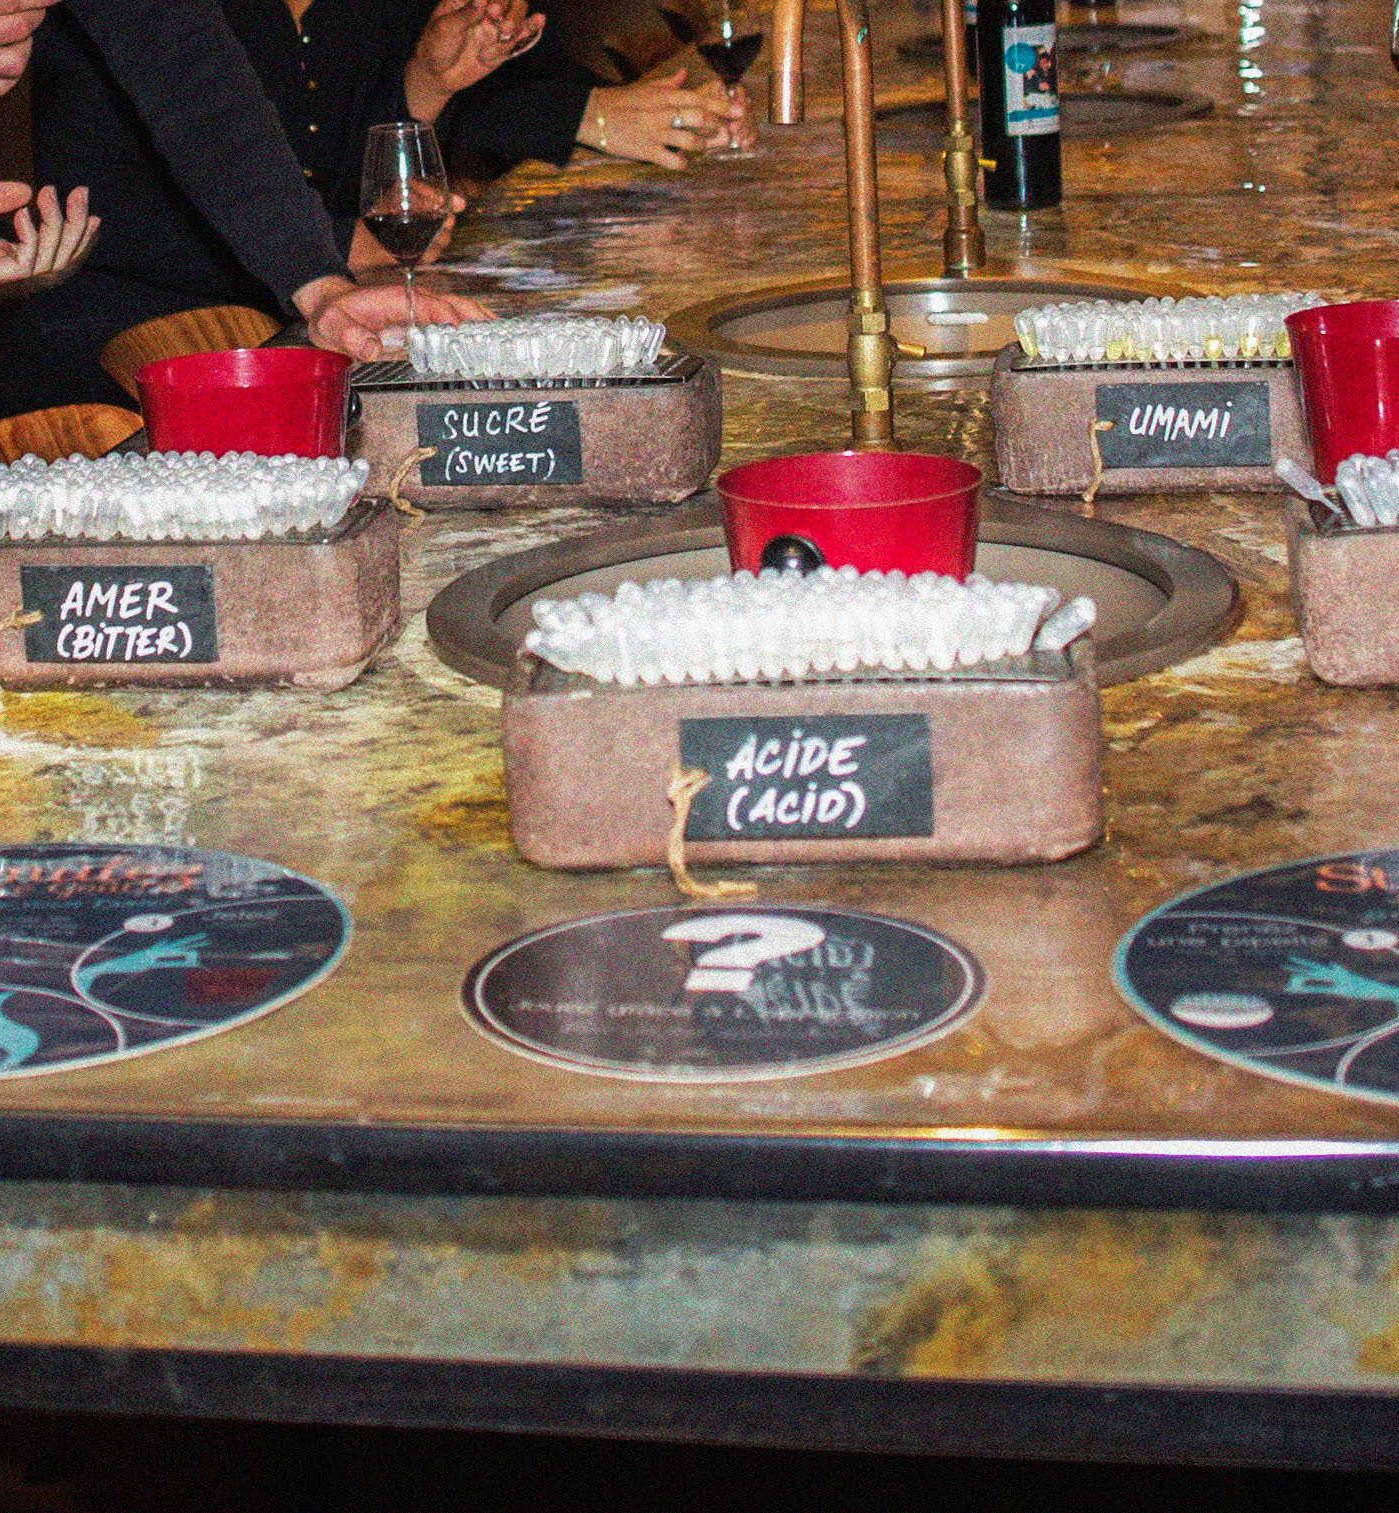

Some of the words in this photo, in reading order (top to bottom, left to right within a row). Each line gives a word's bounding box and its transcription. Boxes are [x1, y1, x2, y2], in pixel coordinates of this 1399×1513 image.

[442, 400, 552, 439] SUCRÉ
[444, 445, 556, 481] (SWEET)
[59, 580, 179, 620] AMER
